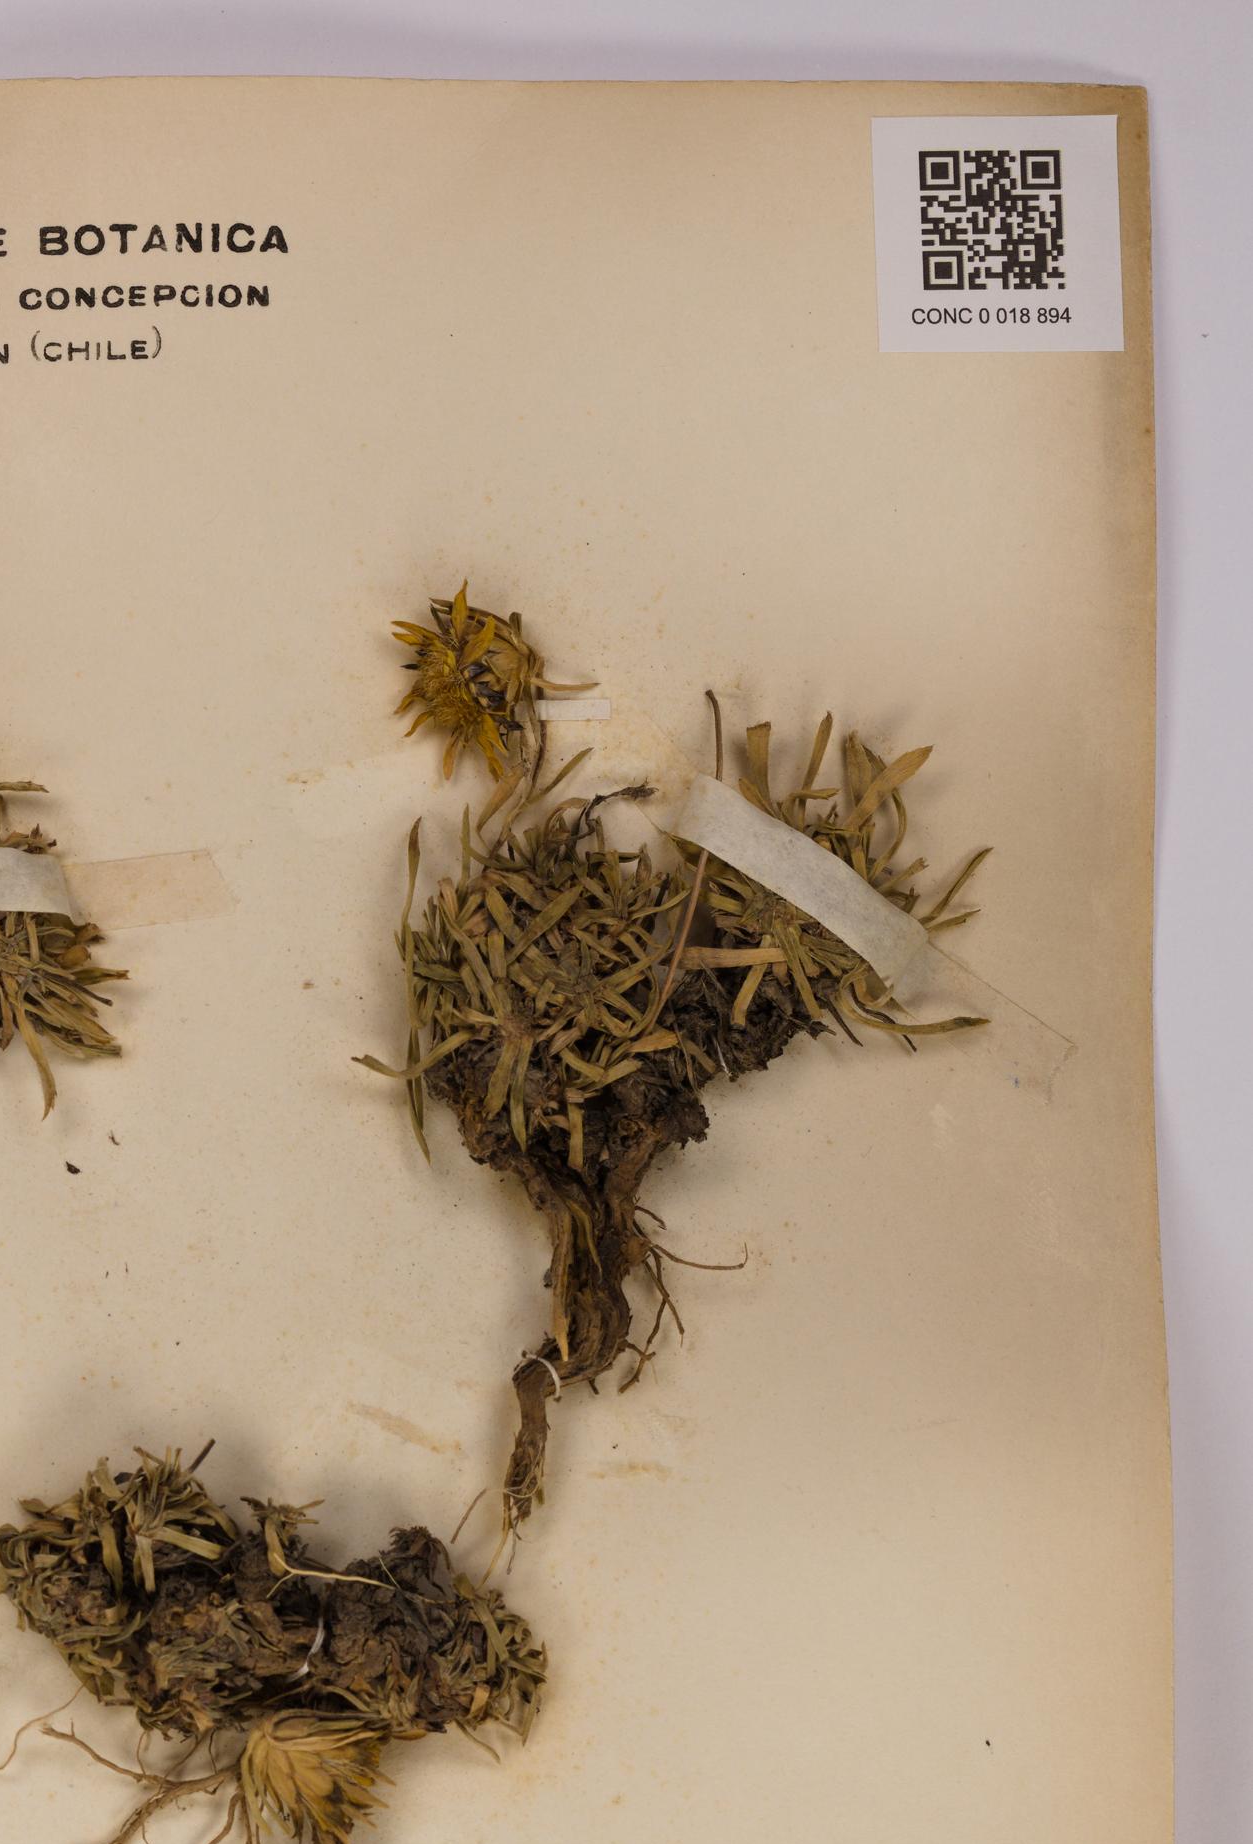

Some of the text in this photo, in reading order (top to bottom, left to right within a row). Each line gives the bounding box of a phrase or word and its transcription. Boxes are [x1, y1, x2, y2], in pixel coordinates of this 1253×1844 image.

[39, 222, 289, 256] BOTANICA
[18, 284, 270, 311] CONCEPCION
[911, 306, 1072, 325] CONC 0 018 894
[30, 325, 162, 363] (CHILE)
